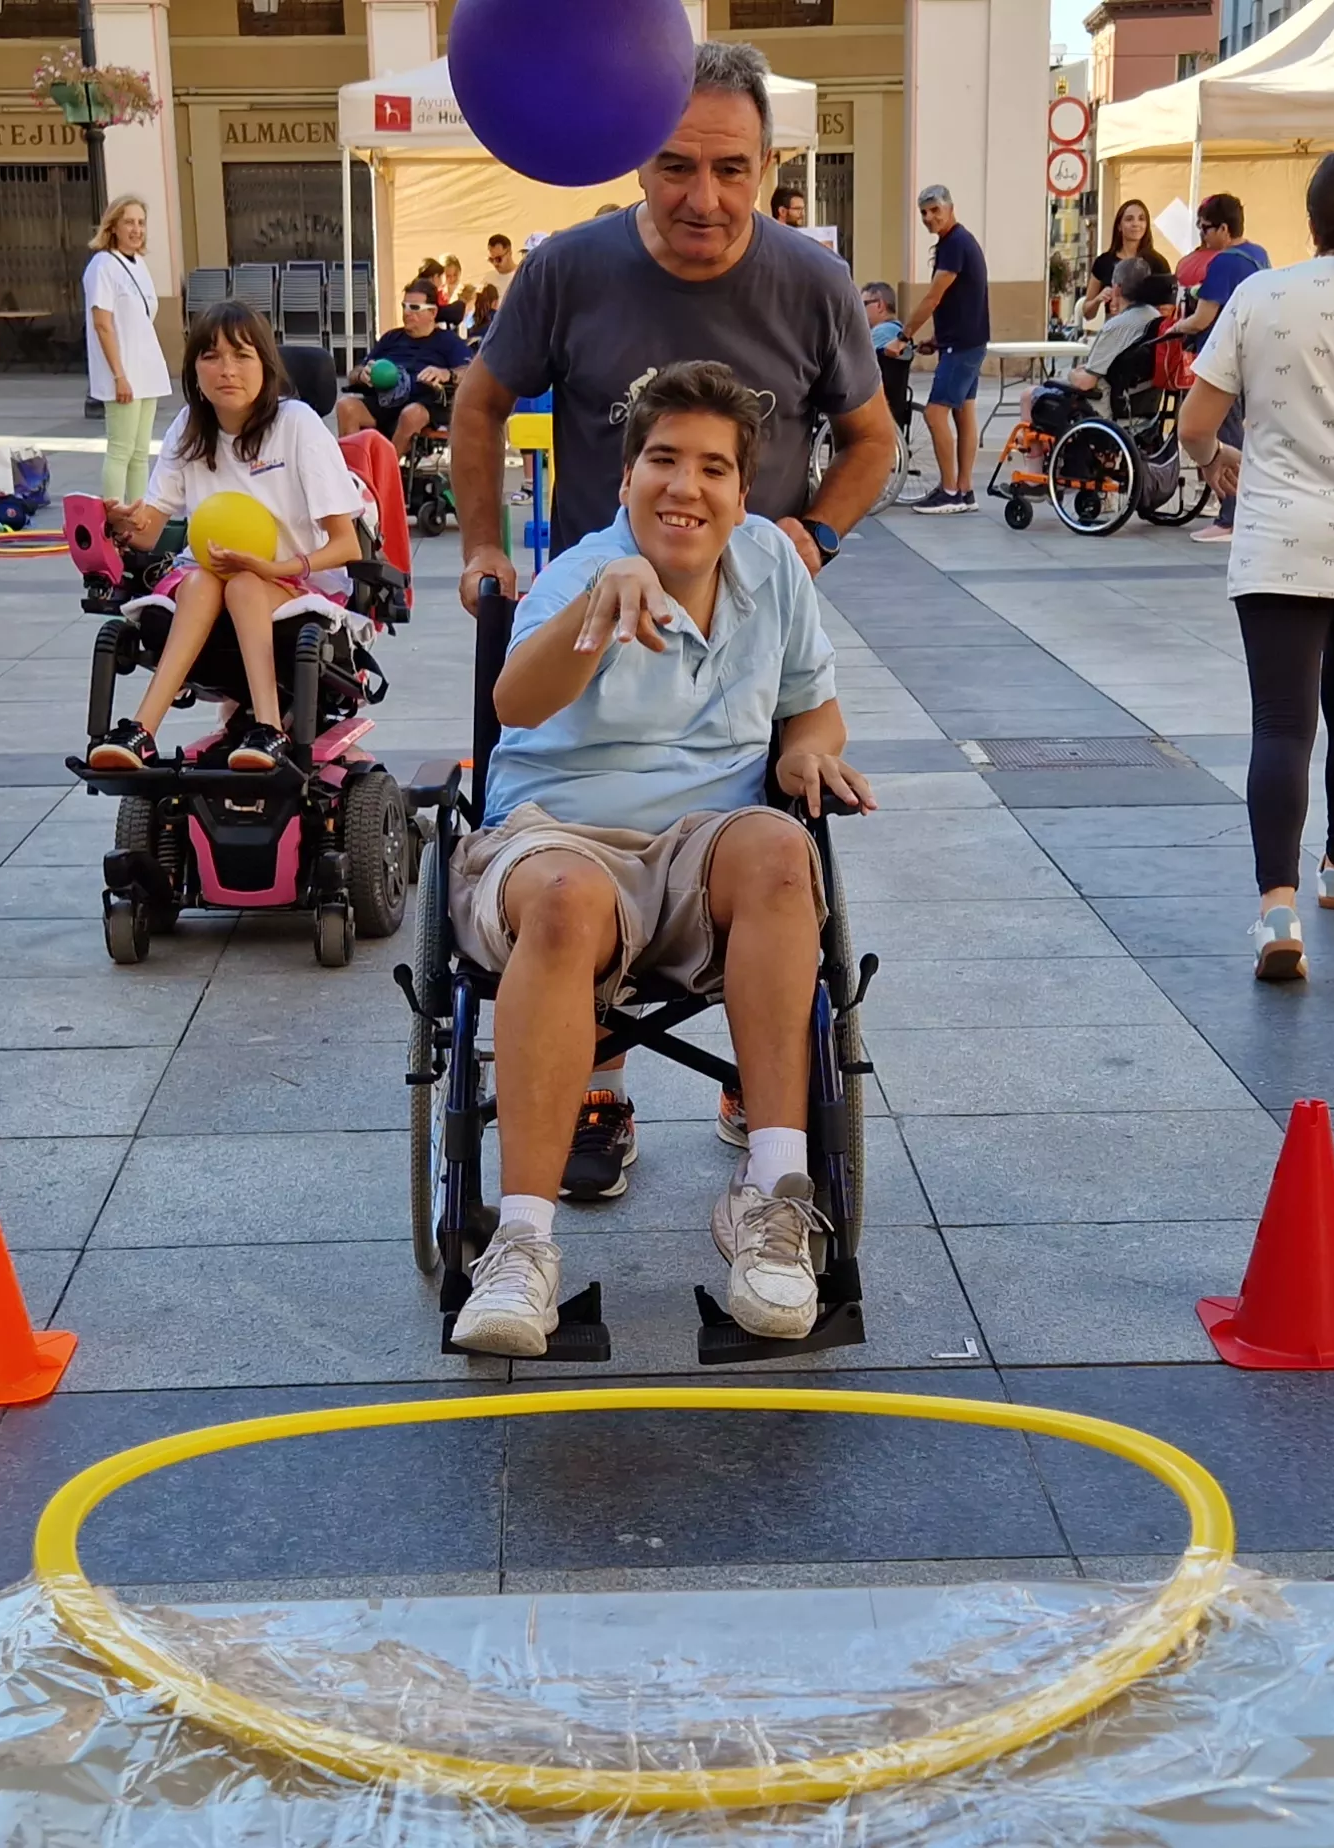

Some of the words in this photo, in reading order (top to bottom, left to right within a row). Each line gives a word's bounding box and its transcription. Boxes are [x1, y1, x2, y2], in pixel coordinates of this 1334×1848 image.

[417, 111, 434, 125] de
[438, 111, 466, 125] Hue
[225, 122, 336, 144] ALMACEN
